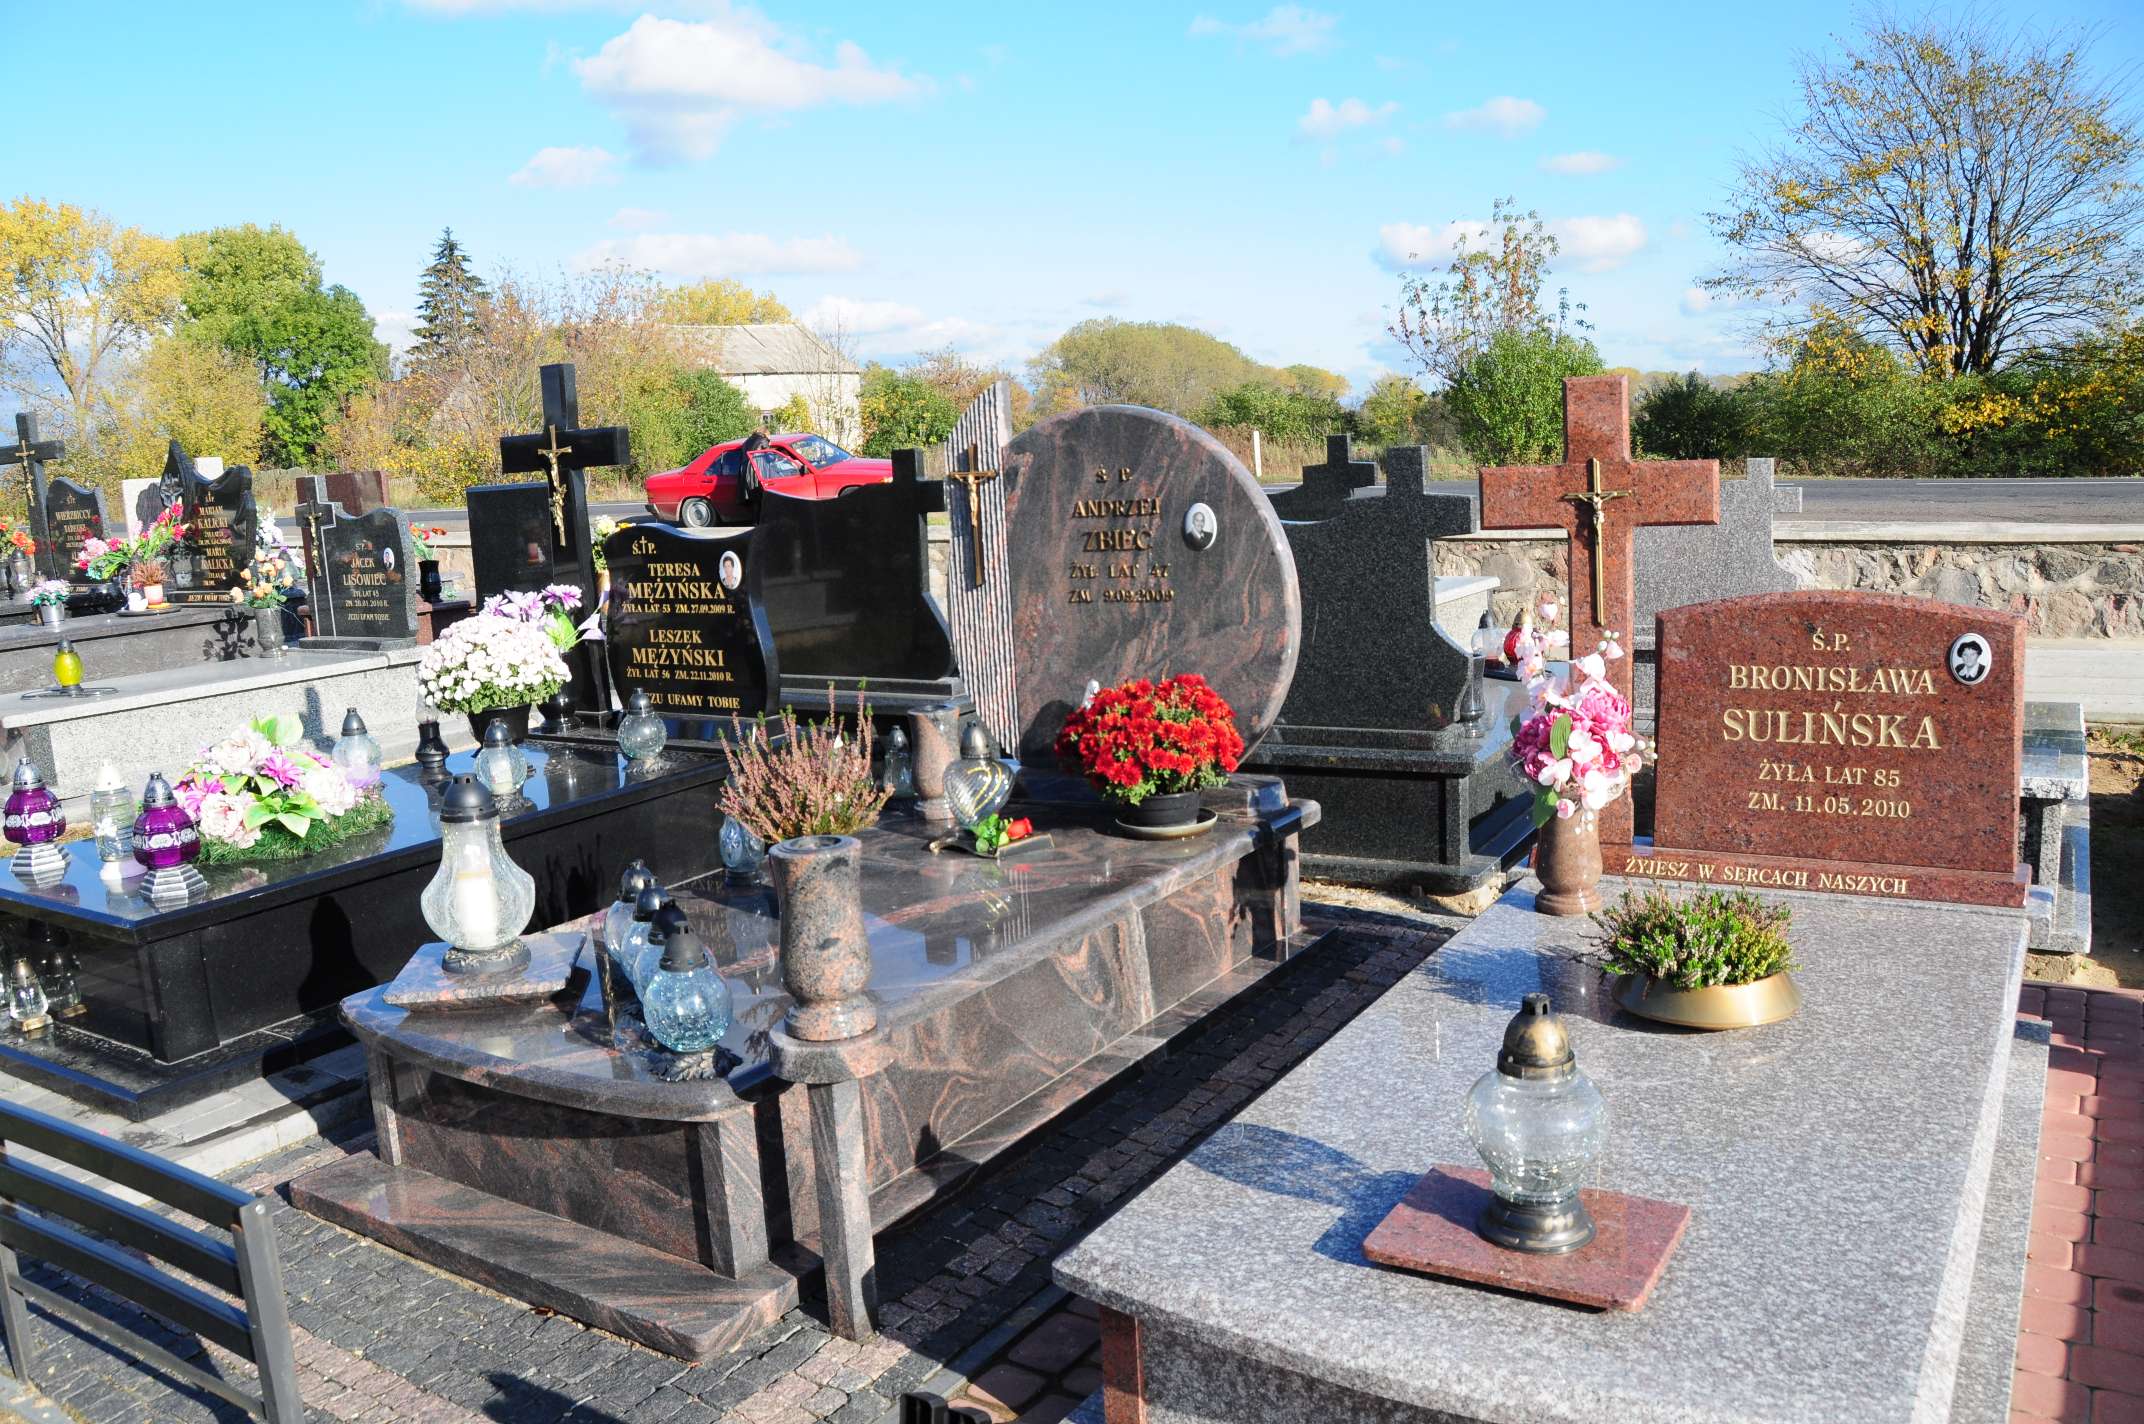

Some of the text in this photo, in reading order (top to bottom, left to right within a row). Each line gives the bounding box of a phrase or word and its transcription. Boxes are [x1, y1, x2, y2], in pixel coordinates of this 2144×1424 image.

[1073, 496, 1162, 518] ANDRZEJ
[198, 518, 228, 529] KALICKI
[206, 547, 226, 557] MARIA
[201, 559, 234, 570] KALICKA
[351, 557, 375, 568] JACEK
[648, 563, 700, 577] TERESA
[1108, 563, 1139, 578] LAT
[343, 573, 387, 586] LISOWIEC
[628, 578, 725, 603] MĘŻYŃSKA
[644, 604, 660, 613] LAT
[662, 604, 671, 614] 53
[675, 604, 690, 614] ZM.
[727, 604, 735, 614] R.
[649, 630, 702, 644] LESZEK
[1812, 627, 1851, 651] Ś.P.
[632, 644, 725, 668] MĘŻYŃSKI
[644, 668, 659, 679] LAT
[662, 669, 670, 679] 56
[675, 669, 690, 680] ZM.
[690, 670, 725, 681] 22.11.2010
[726, 671, 735, 681] R.
[1728, 664, 1938, 696] BRONISŁAWA
[668, 693, 703, 707] UFAMY
[708, 695, 740, 709] TOBIE
[1722, 701, 1942, 750] SULIŃSKA
[1758, 757, 1901, 788] ŻYŁA LAT 85
[1747, 790, 1911, 819] ZM. 11.05.2010
[1625, 857, 1907, 894] ŻYJESZ W SERCACH NASZYCH
